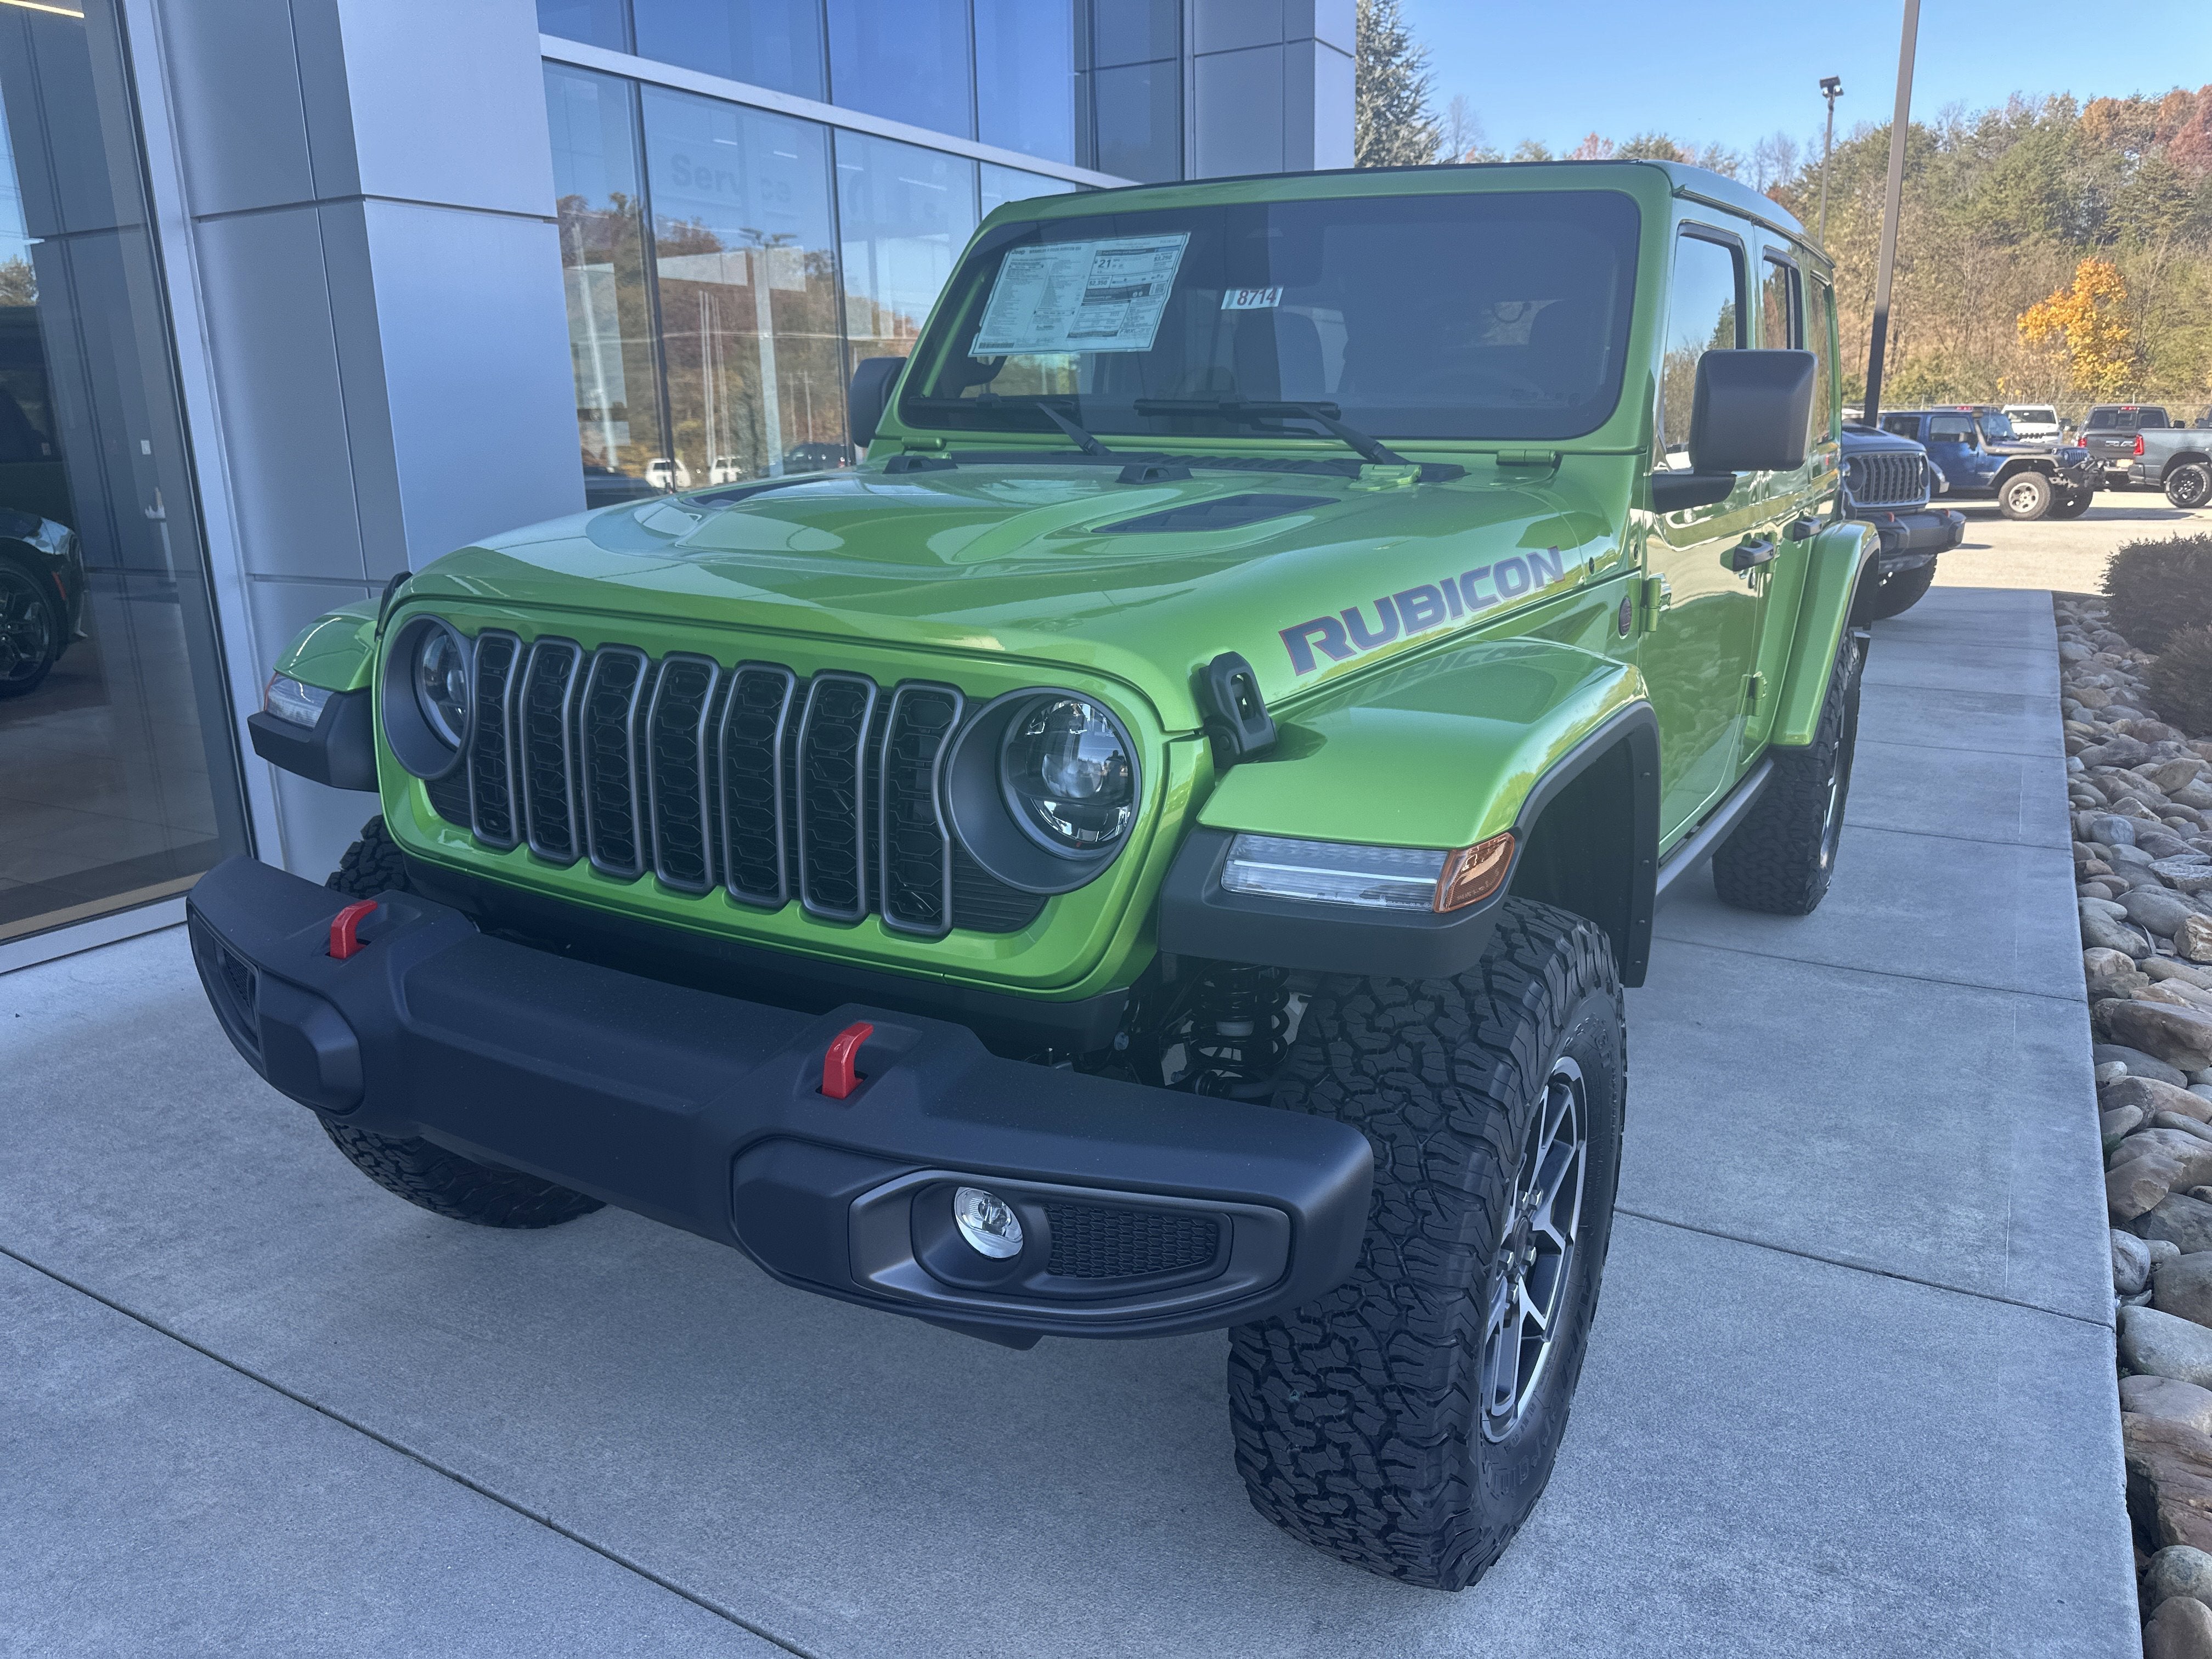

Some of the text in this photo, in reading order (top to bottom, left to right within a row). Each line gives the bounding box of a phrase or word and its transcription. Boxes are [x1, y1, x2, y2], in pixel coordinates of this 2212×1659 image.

[1098, 259, 1111, 268] 21
[1237, 287, 1278, 306] 8714
[1278, 545, 1565, 676] RUBICON
